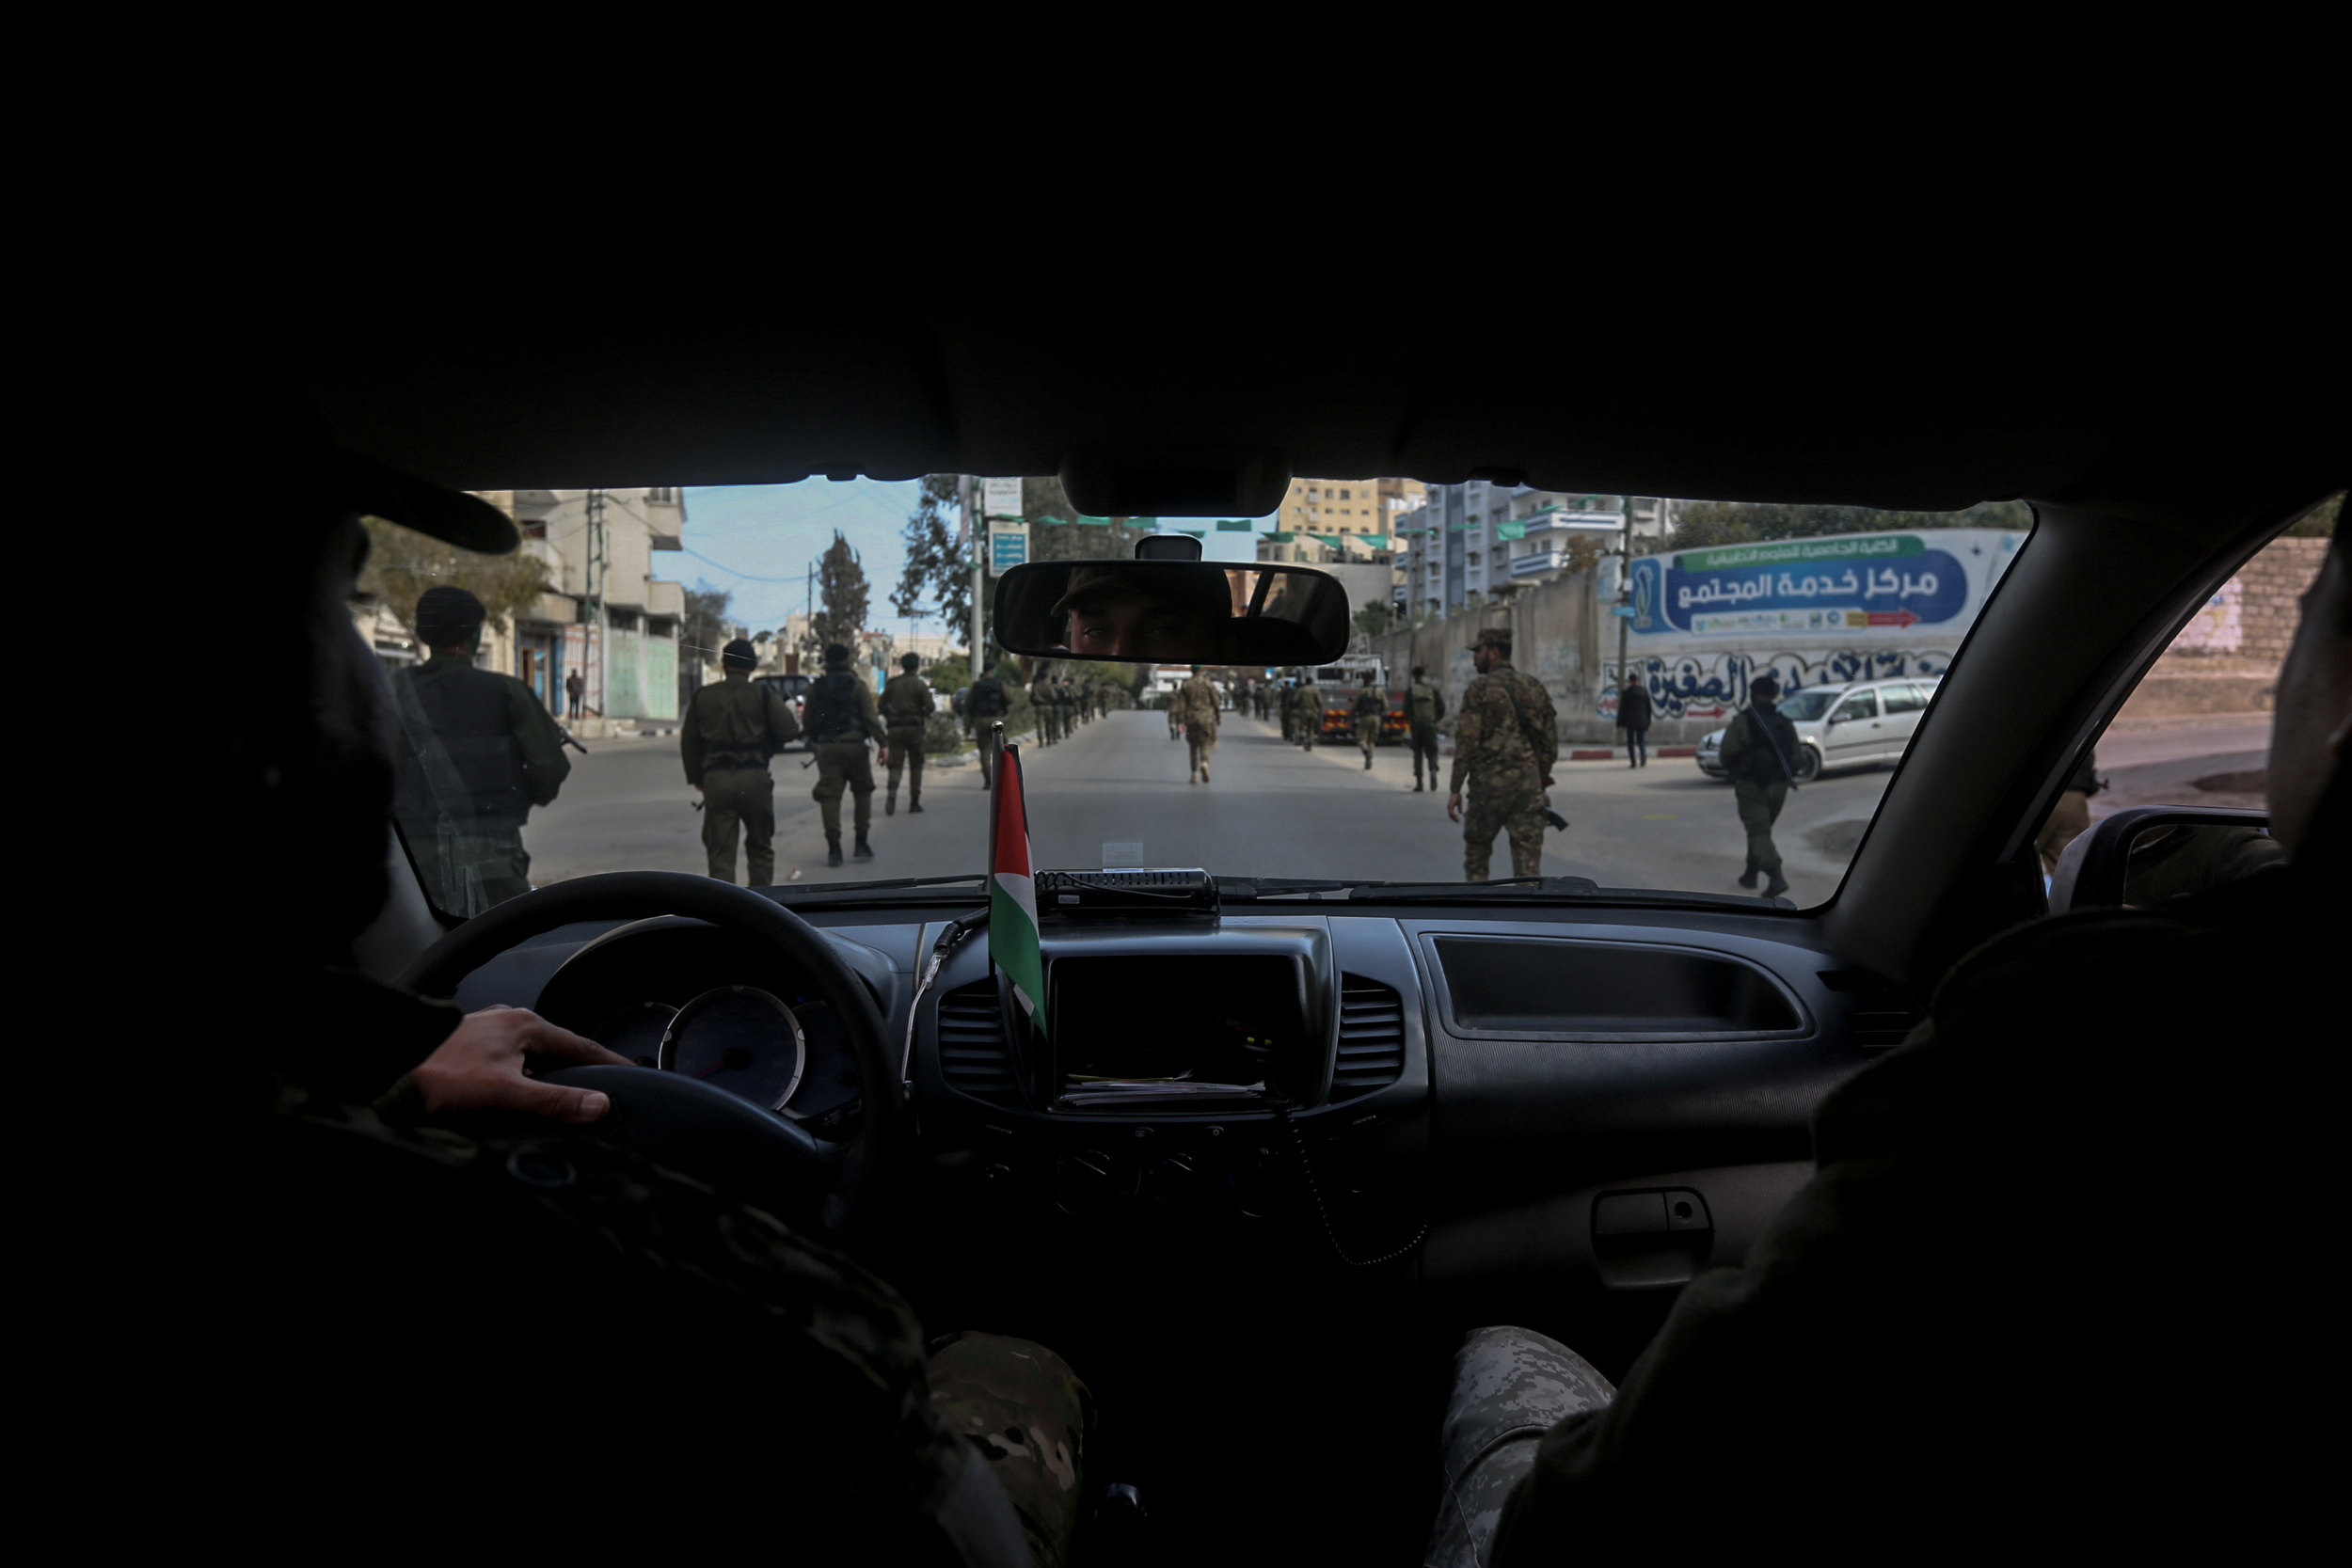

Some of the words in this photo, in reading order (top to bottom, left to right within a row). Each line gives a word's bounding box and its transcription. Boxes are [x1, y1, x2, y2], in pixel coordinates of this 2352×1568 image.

[1677, 575, 1772, 610] المجتمع
[1779, 570, 1860, 598] خدمة
[1864, 567, 1939, 600] مركز
